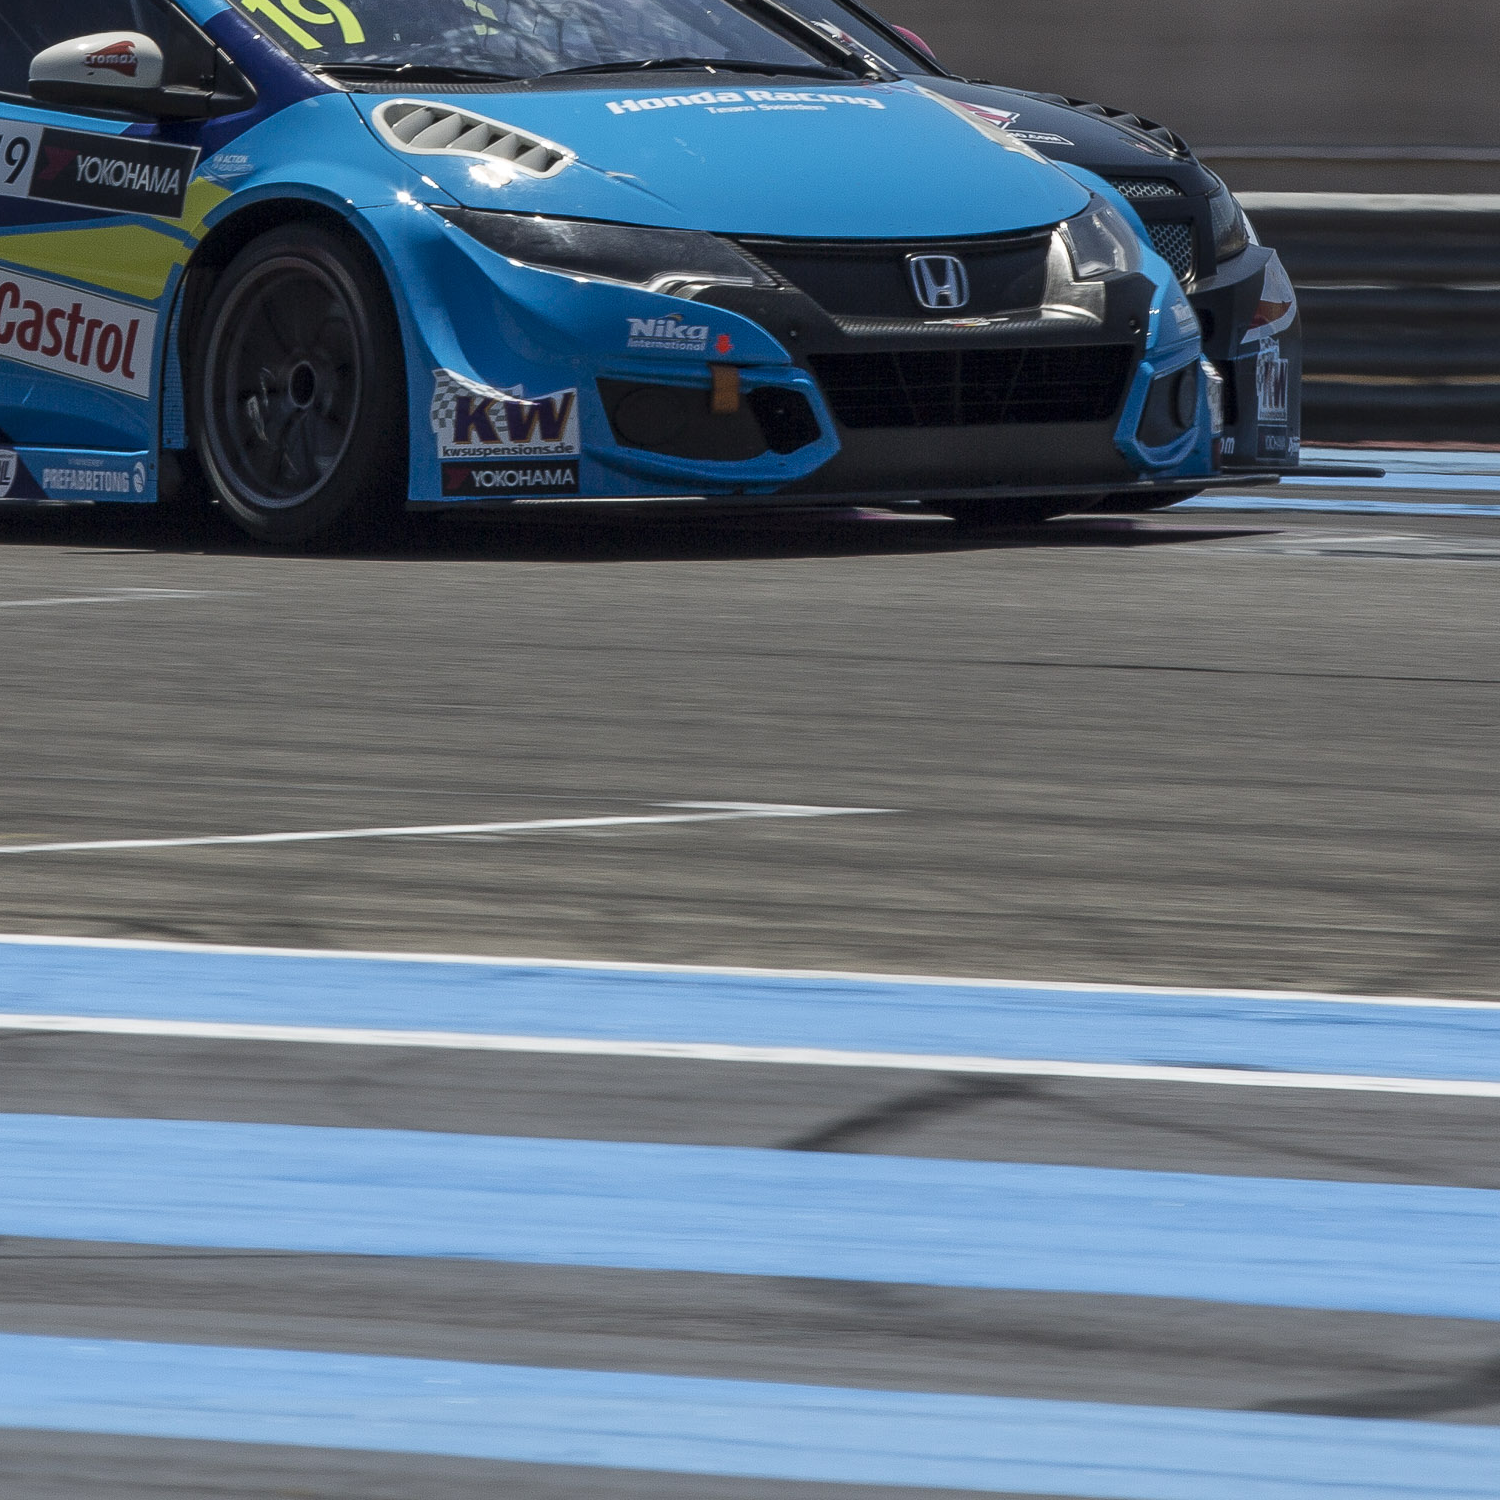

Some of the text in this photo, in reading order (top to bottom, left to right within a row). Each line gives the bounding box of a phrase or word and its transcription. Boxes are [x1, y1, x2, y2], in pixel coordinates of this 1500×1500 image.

[605, 89, 888, 116] Honda Racing
[704, 102, 829, 115] Team Sweden
[76, 155, 180, 196] YOKOHAMA
[626, 316, 710, 340] Nika
[627, 338, 707, 351] International
[453, 391, 577, 445] KW
[442, 442, 575, 458] kwsuspensions.de
[42, 468, 130, 493] PREFABBETONG
[471, 468, 576, 488] YOKOHAMA
